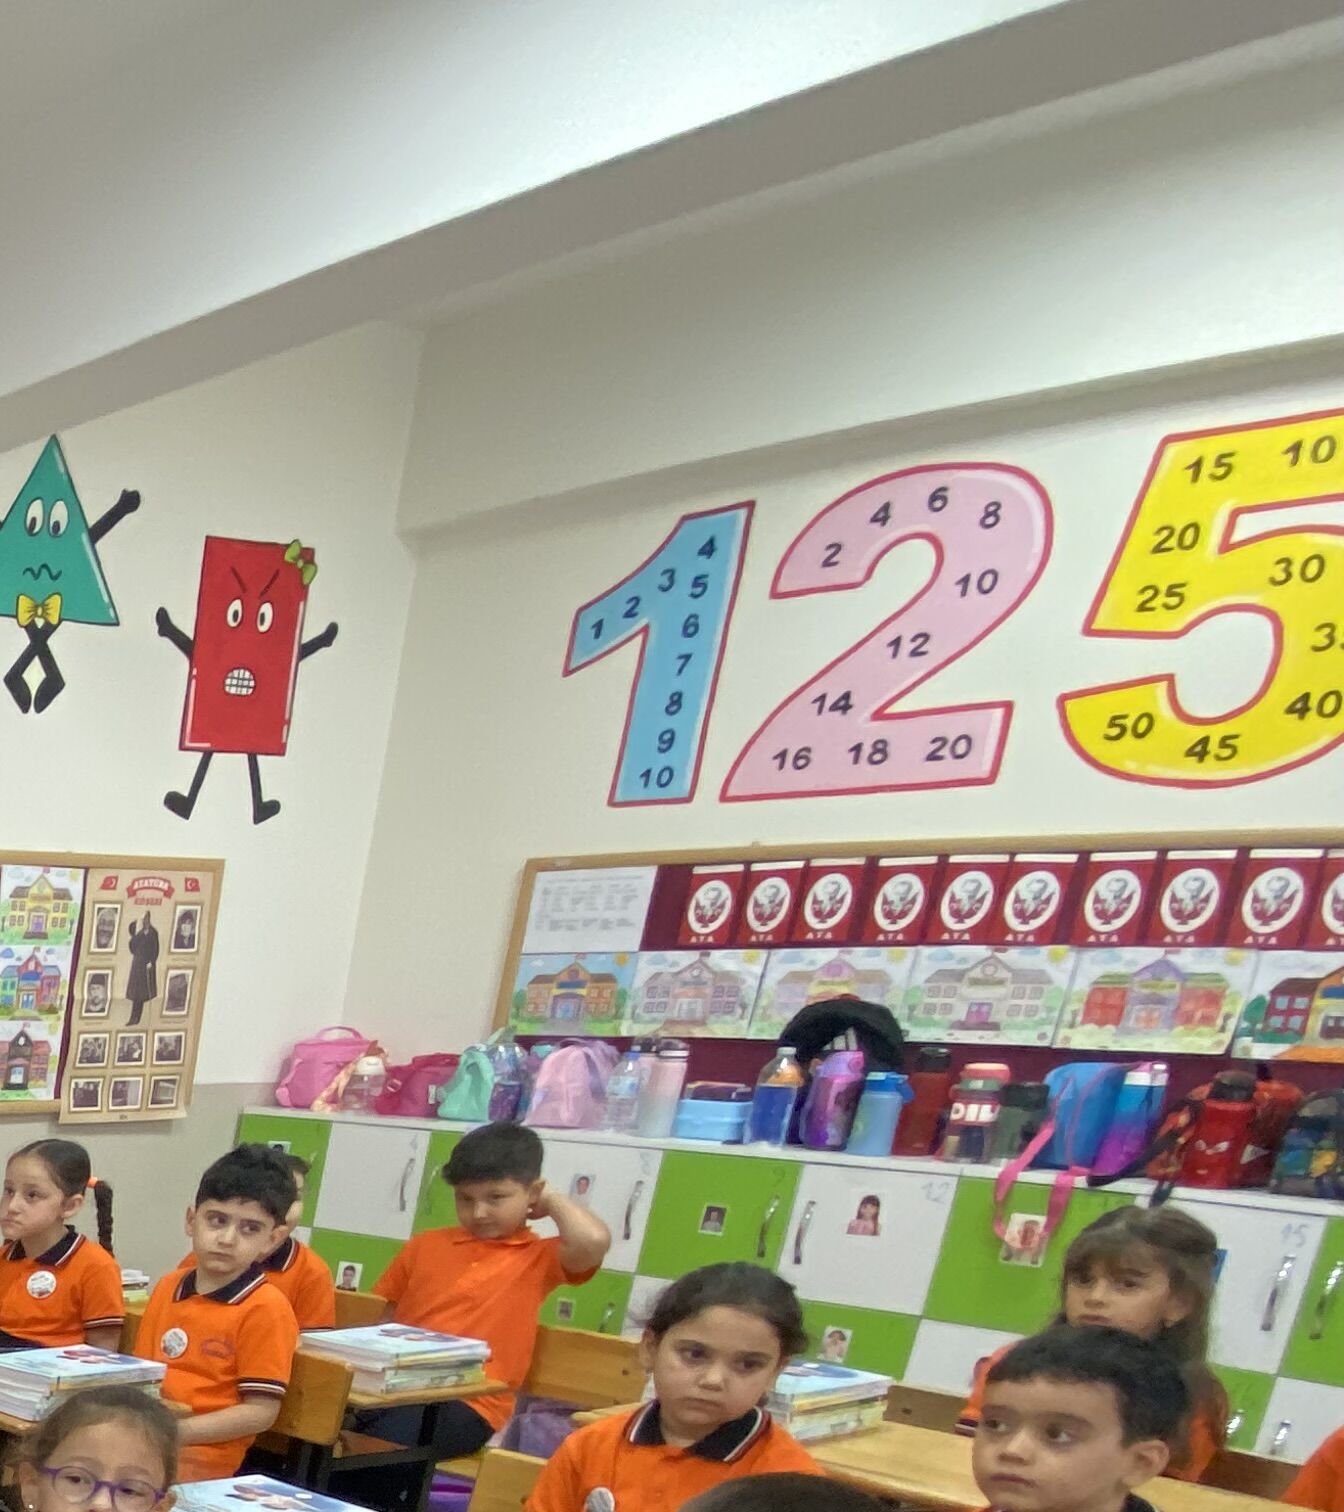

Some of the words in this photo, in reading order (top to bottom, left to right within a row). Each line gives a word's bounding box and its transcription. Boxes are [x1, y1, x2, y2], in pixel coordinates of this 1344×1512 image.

[1282, 435, 1336, 467] 10
[1184, 452, 1235, 483] 15
[928, 487, 949, 512] 6
[870, 501, 892, 526] 4
[980, 501, 1002, 528] 8
[698, 535, 717, 559] 4
[1150, 522, 1200, 554] 20
[821, 543, 842, 568] 2
[658, 568, 676, 592] 3
[1268, 554, 1325, 586] 30
[689, 575, 708, 598] 5
[955, 569, 998, 597] 10
[622, 597, 641, 618] 2
[1134, 582, 1189, 613] 25
[591, 619, 604, 639] 1
[682, 614, 699, 638] 6
[1310, 622, 1344, 653] 3
[887, 633, 931, 659] 12
[676, 654, 692, 676] 7
[665, 691, 682, 715] 8
[811, 690, 853, 715] 14
[1284, 690, 1342, 720] 40
[1103, 712, 1155, 741] 50
[658, 729, 675, 753] 9
[772, 747, 811, 770] 16
[848, 739, 888, 765] 18
[925, 734, 972, 761] 20
[1183, 734, 1241, 763] 45
[640, 766, 673, 788] 10
[690, 934, 713, 943] ATA
[749, 933, 773, 942] ATA
[805, 931, 832, 940] ATA
[876, 932, 904, 941] ATA
[940, 931, 970, 941] ATA
[1004, 933, 1035, 942] ATA
[1087, 934, 1119, 943] ATA
[1163, 935, 1195, 944] ATA
[1244, 936, 1277, 944] ATA
[921, 1181, 953, 1203] 12
